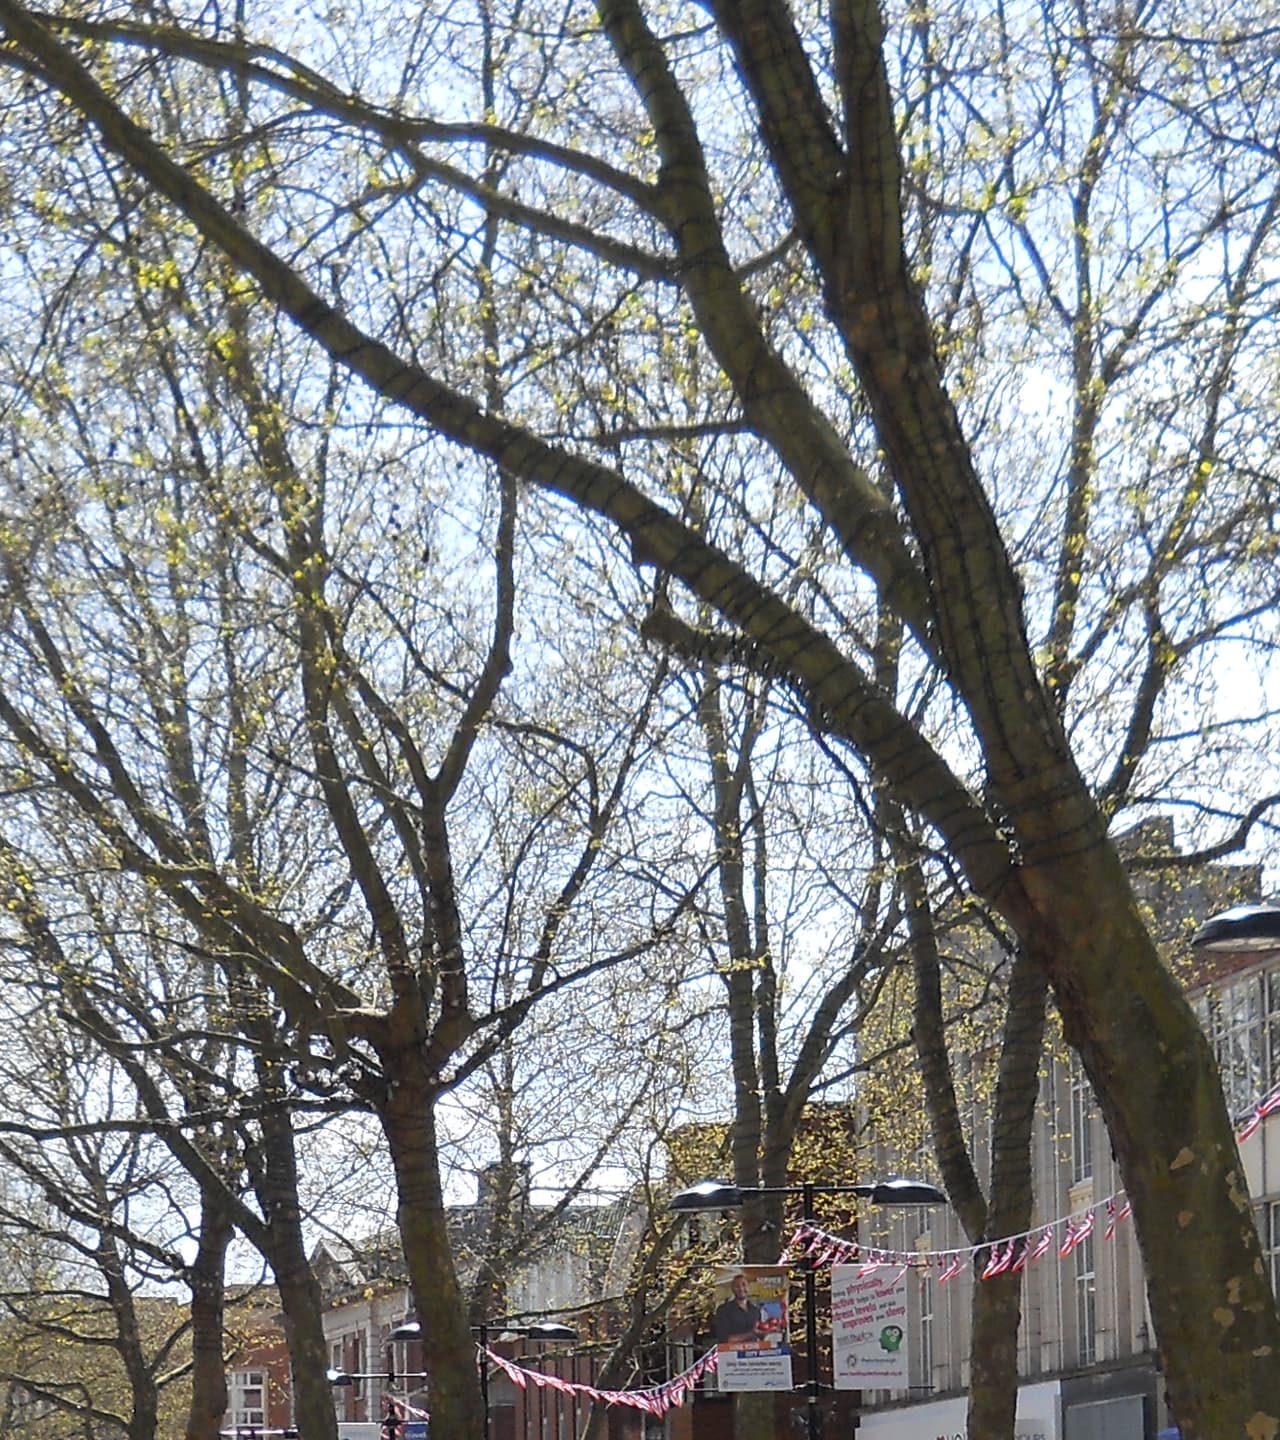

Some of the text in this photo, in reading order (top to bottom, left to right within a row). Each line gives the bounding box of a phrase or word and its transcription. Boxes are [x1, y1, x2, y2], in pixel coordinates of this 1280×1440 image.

[847, 1278, 883, 1296] physically
[831, 1298, 855, 1309] active
[875, 1287, 894, 1298] lower
[831, 1310, 854, 1320] stress
[855, 1303, 877, 1315] levels
[842, 1315, 874, 1329] improves
[885, 1306, 906, 1317] sleep
